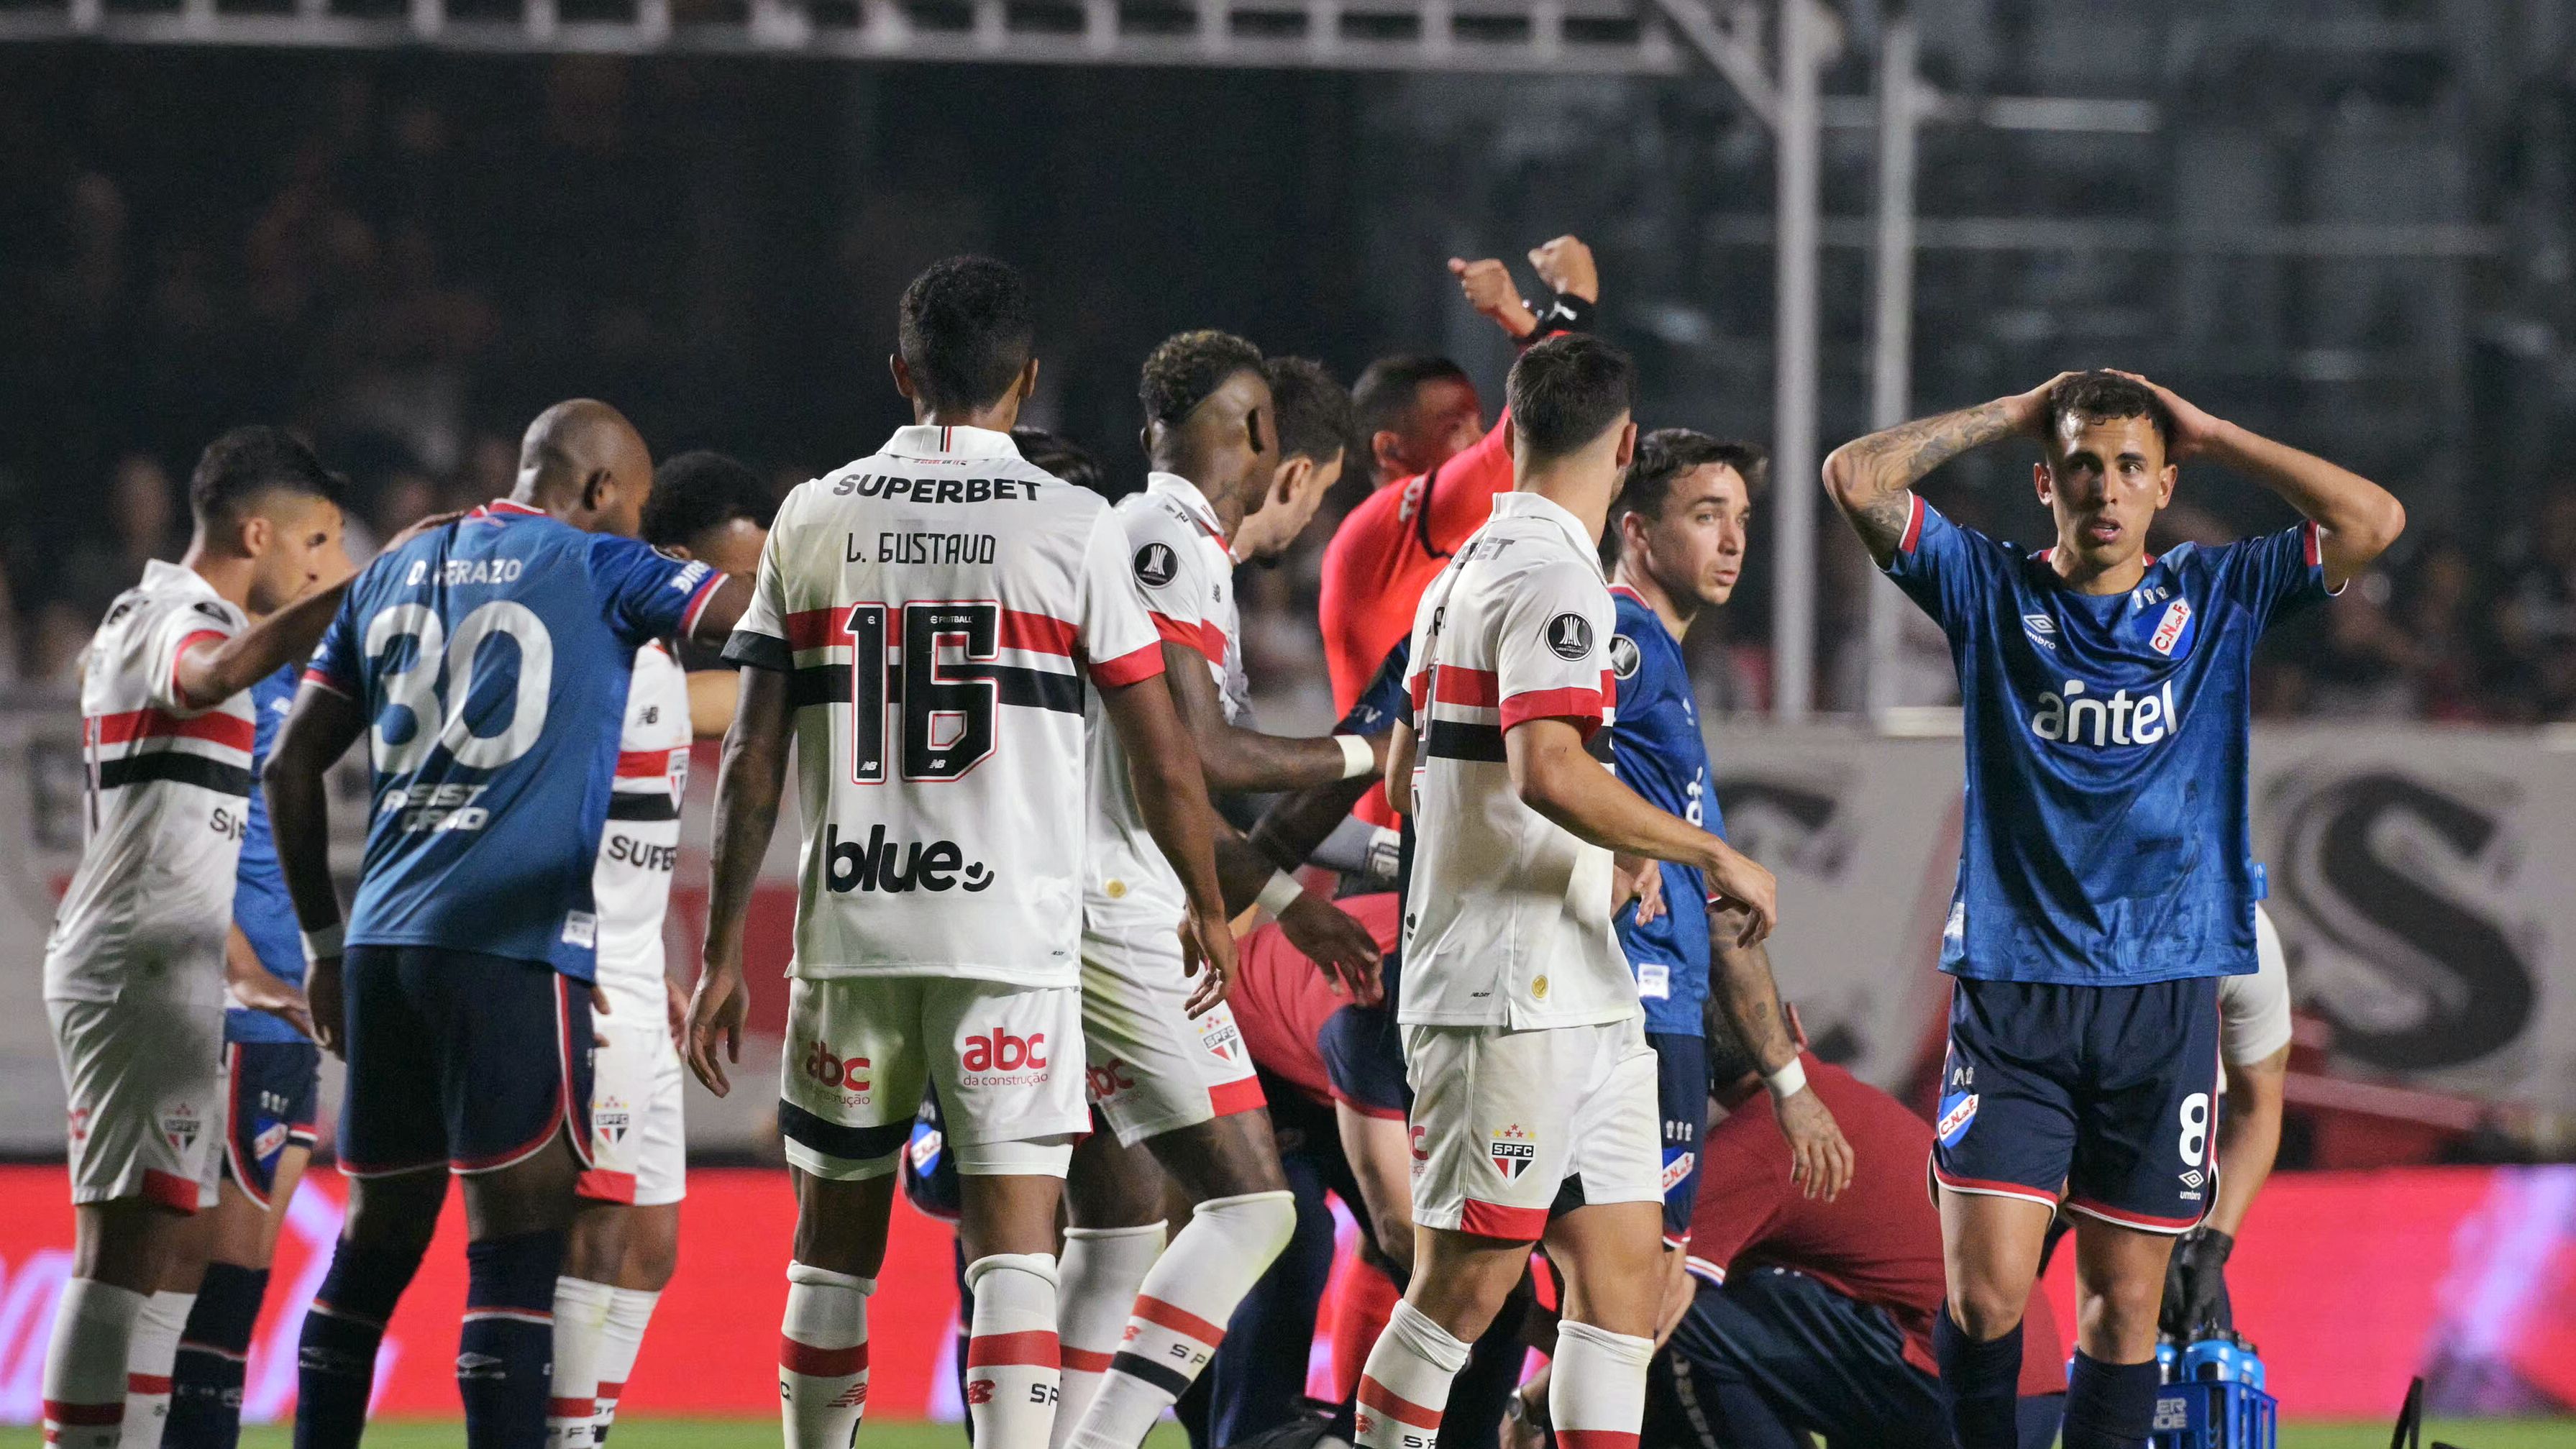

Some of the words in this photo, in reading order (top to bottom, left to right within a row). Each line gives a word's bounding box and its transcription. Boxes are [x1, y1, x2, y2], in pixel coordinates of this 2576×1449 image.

[833, 472, 1041, 503] SUPERBET
[847, 532, 867, 564] L.
[878, 532, 996, 564] GUSTAVO
[365, 599, 554, 775] 30
[844, 600, 1001, 785] 16
[2032, 679, 2177, 746] antel
[826, 823, 963, 894] blue
[963, 1027, 1047, 1072] abc
[1204, 1025, 1236, 1048] SPFC
[806, 1040, 870, 1092] abc
[963, 1075, 979, 1086] da
[982, 1072, 1049, 1087] construção
[1493, 1144, 1533, 1156] SPFC
[2179, 1092, 2209, 1167] 8
[2180, 1191, 2201, 1201] umbro
